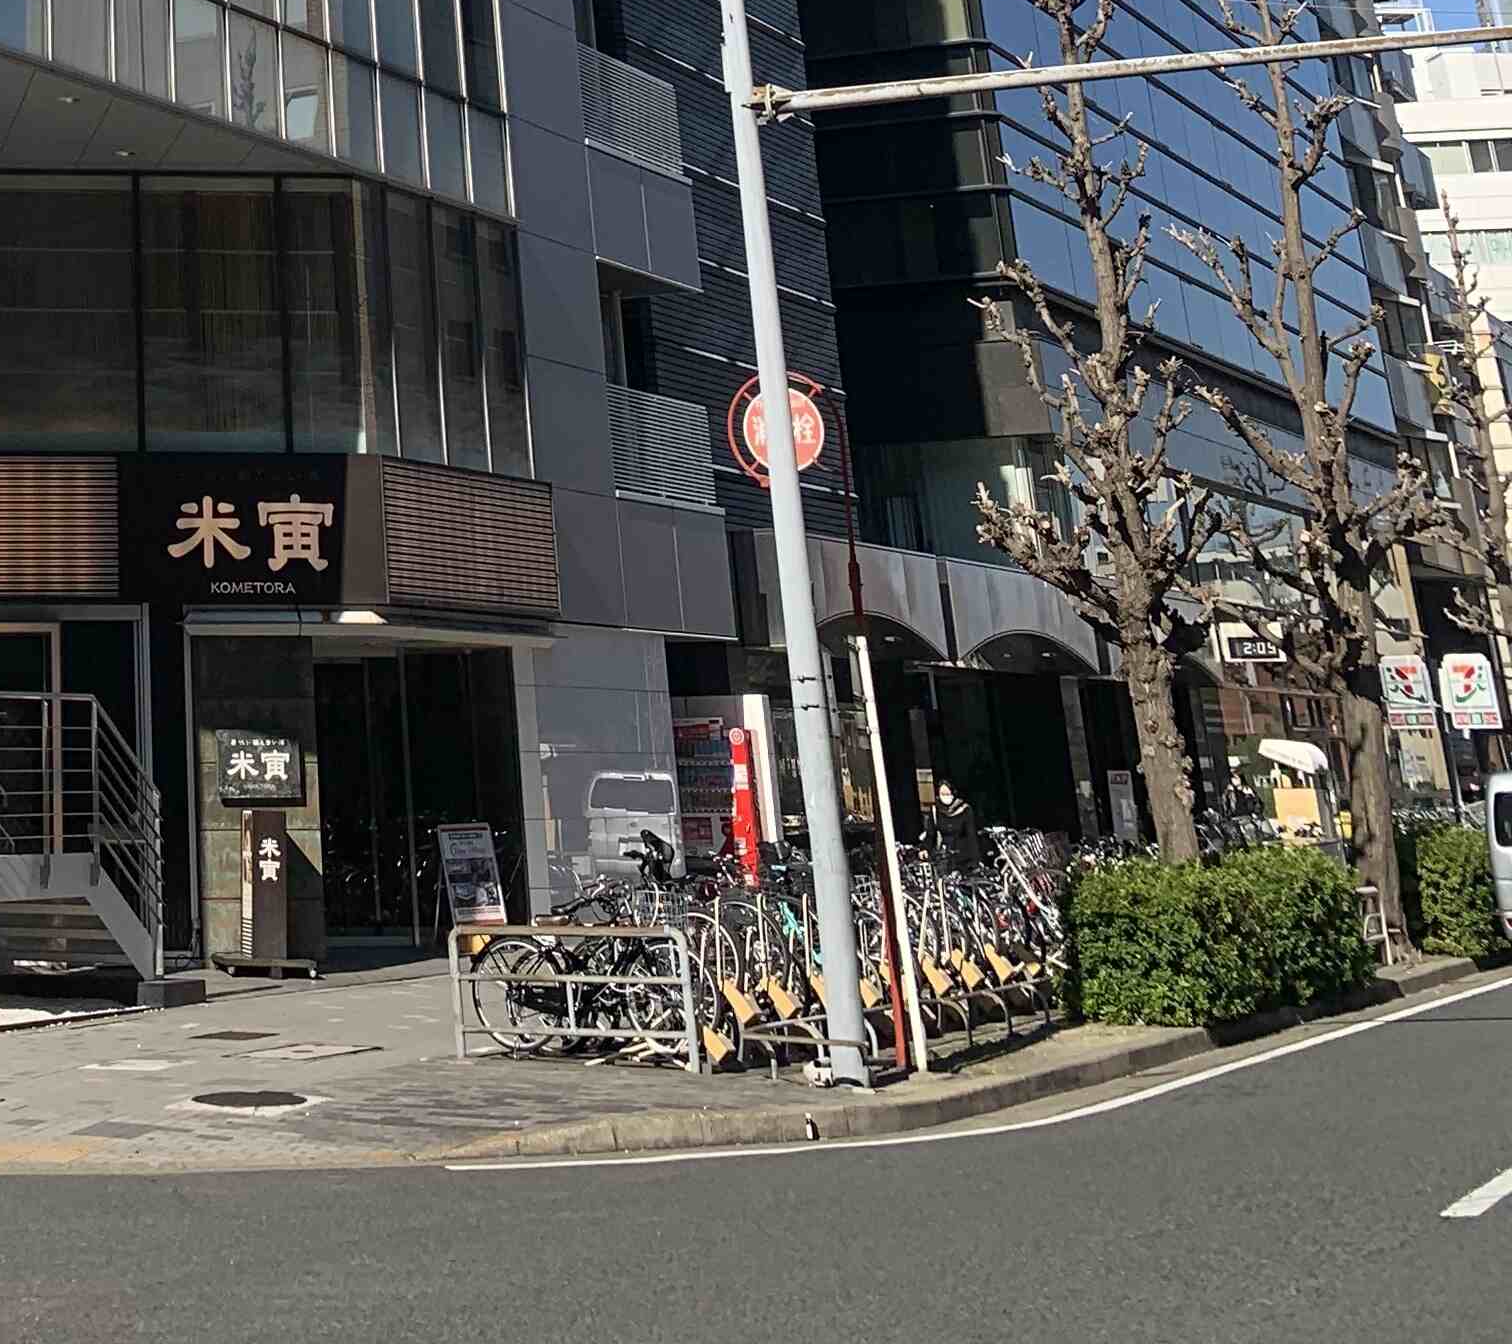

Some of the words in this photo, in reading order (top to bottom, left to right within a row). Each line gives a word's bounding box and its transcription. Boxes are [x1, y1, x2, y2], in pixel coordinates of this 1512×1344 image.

[751, 413, 818, 445] 消栓
[167, 493, 335, 572] 米寅
[210, 581, 297, 595] KOMETORA
[226, 749, 290, 781] 米寅
[258, 837, 281, 881] 米寅
